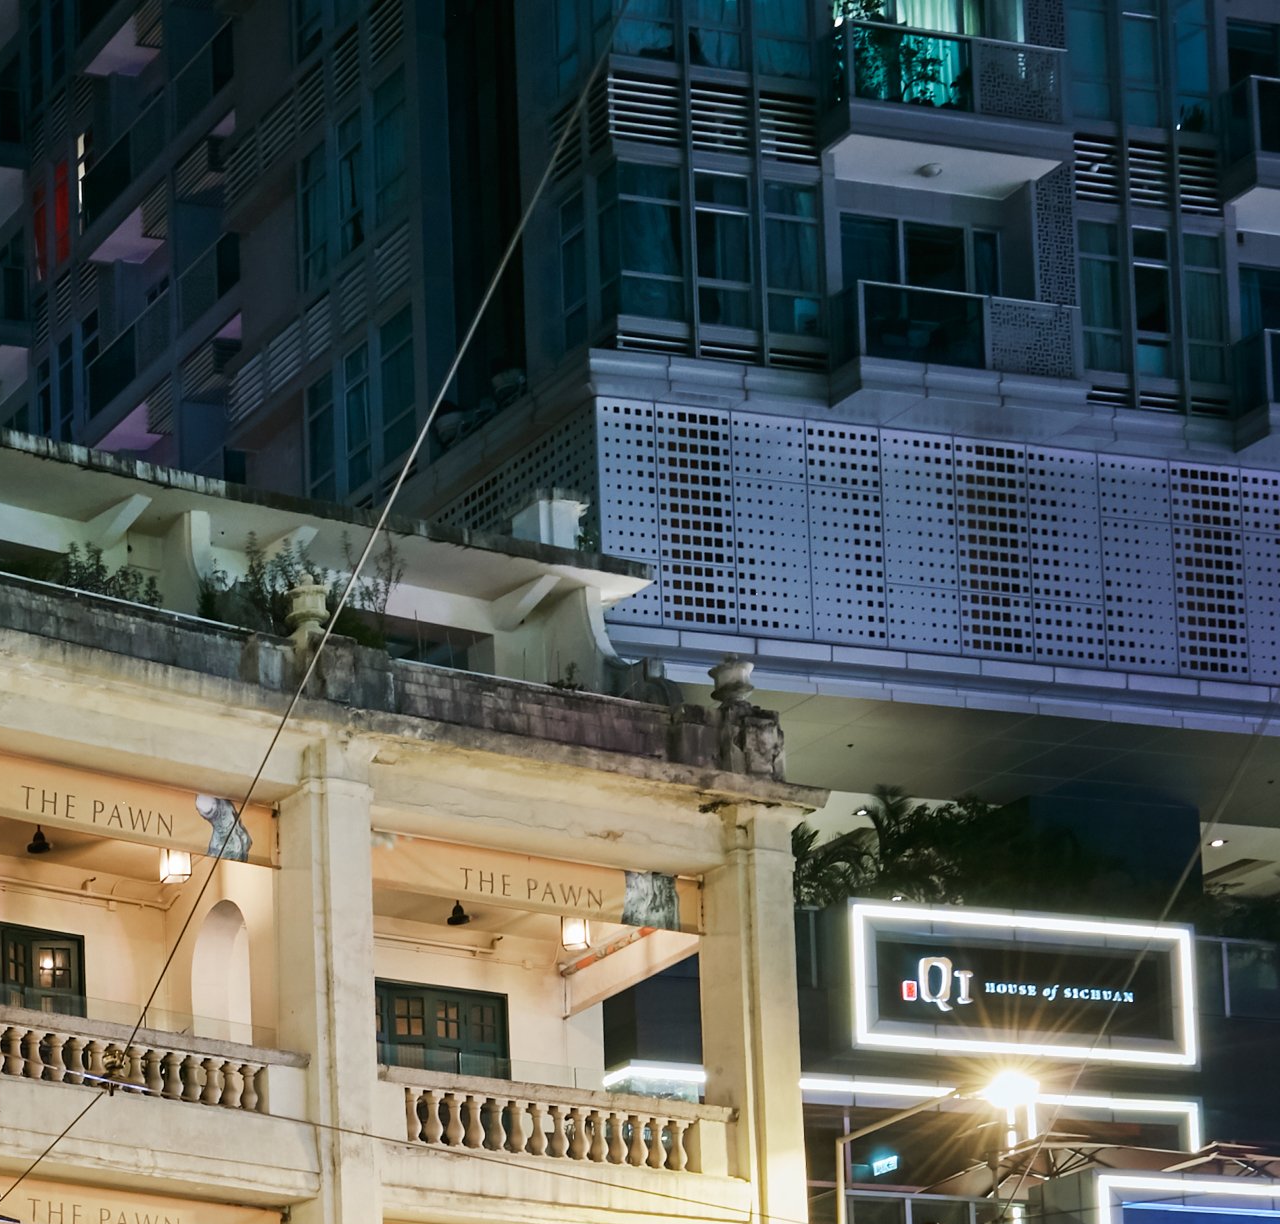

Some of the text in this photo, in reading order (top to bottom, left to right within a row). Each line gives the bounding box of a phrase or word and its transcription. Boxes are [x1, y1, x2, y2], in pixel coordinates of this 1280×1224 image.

[20, 785, 175, 837] THE PAWN
[459, 866, 606, 911] THE PAWN
[985, 982, 1037, 997] HOUSE
[1042, 984, 1060, 1001] of
[1063, 987, 1134, 1003] SICHUAN
